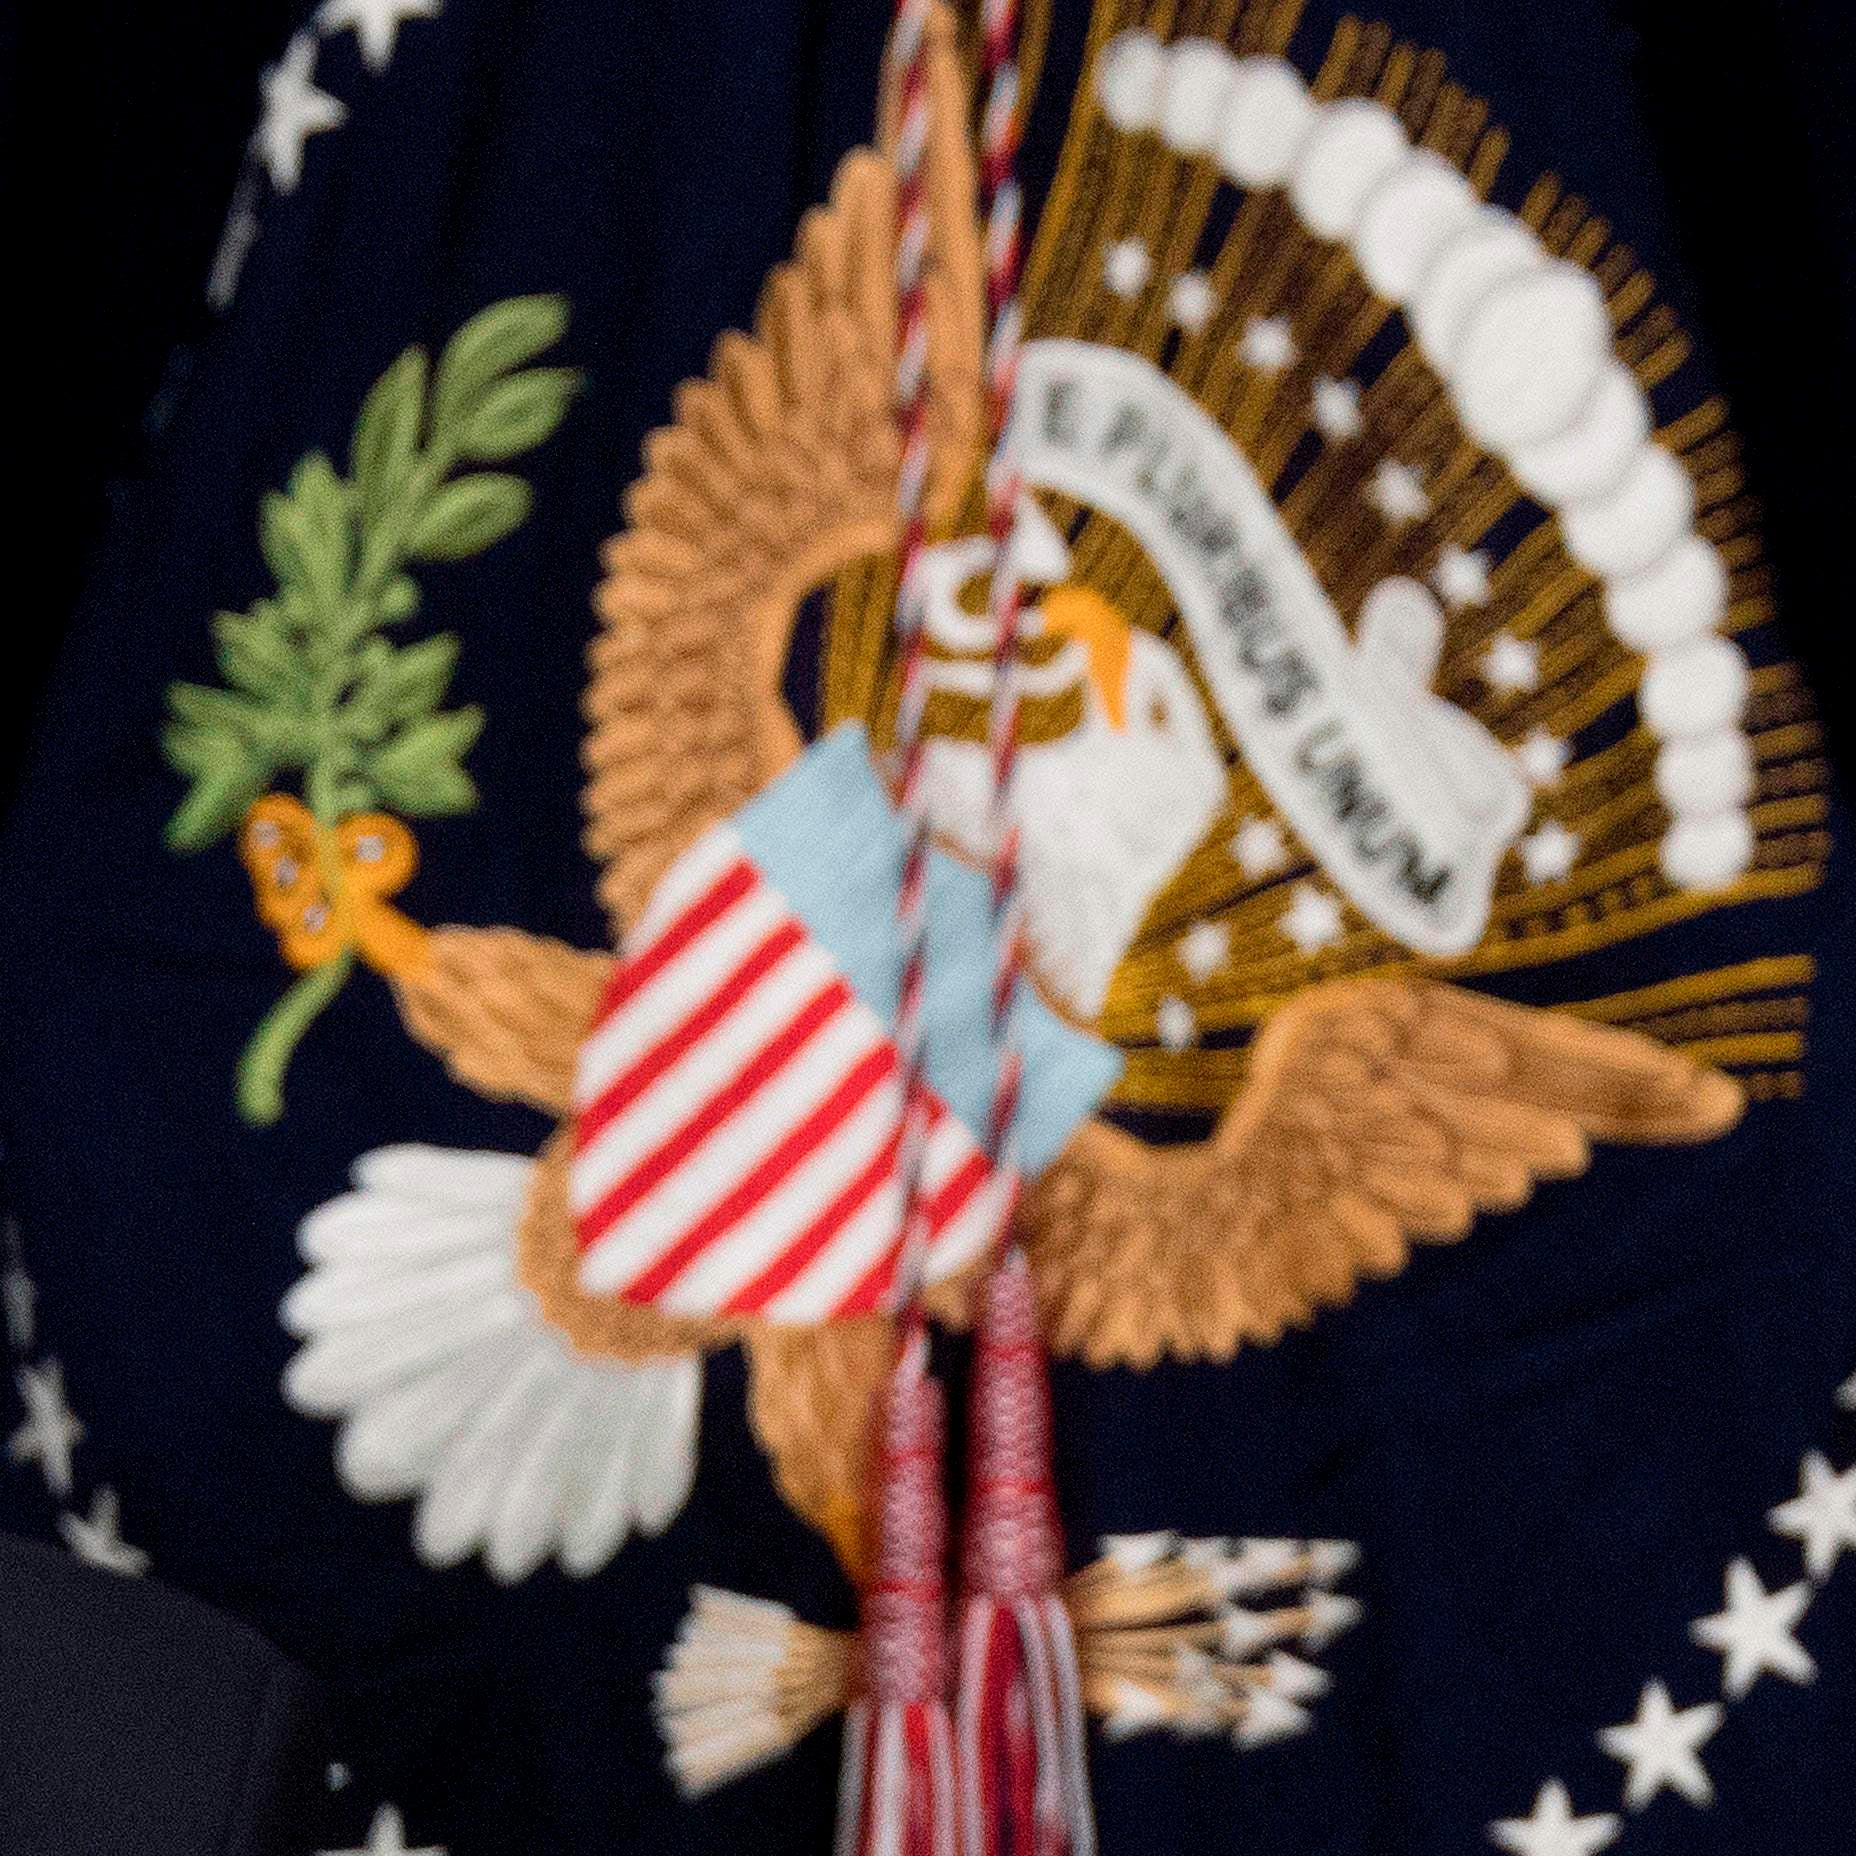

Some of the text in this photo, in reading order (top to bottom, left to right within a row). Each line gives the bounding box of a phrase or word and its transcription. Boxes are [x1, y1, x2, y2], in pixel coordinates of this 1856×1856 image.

[1043, 376, 1455, 906] E PLURIBUS UNUM
